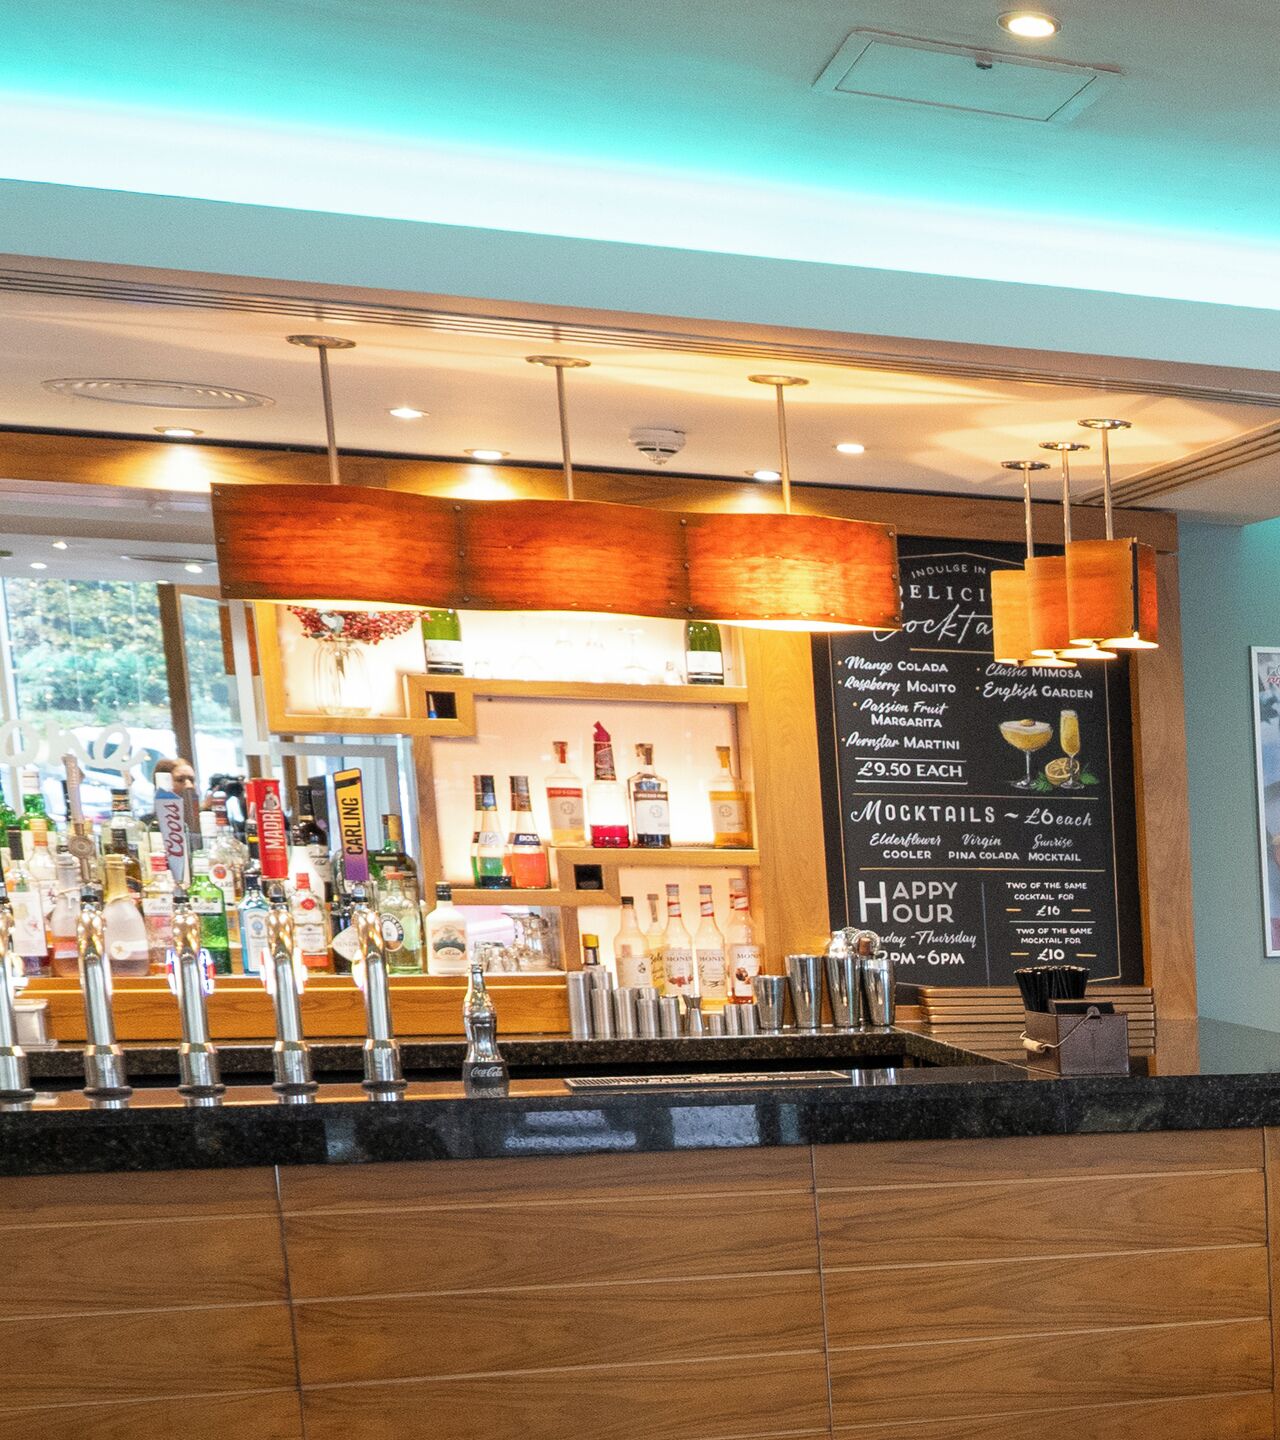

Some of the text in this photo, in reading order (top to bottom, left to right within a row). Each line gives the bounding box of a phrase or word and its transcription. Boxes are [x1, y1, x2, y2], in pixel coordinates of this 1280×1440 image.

[911, 564, 986, 578] INDULGE IN
[900, 585, 992, 602] ELICI
[845, 656, 948, 676] Mango COLADA
[1031, 667, 1082, 678] MIMOSA
[844, 676, 956, 696] Raspberry MOJITO
[983, 682, 1093, 702] English GARDEN
[860, 698, 949, 715] Passion Fruit
[871, 714, 942, 728] MARGARITA
[846, 731, 960, 751] Pornstar MARTINI
[857, 761, 962, 777] £9.50 EACH
[850, 800, 995, 824] MOCKTAILS
[163, 802, 184, 858] Coors
[341, 797, 364, 856] CARLING
[869, 832, 942, 849] Elderflower
[961, 833, 1002, 848] Virgin
[1032, 833, 1073, 849] Sunrise
[883, 850, 931, 859] COOLER
[948, 851, 1020, 860] PINA COLADA
[1028, 852, 1081, 862] MOCKTAIL
[1006, 882, 1027, 890] TWO
[1029, 882, 1041, 890] OF
[1064, 882, 1087, 890] SAME
[1014, 893, 1074, 901] COCKTAIL FOR
[1036, 905, 1060, 916] £16
[1037, 948, 1065, 961] £10
